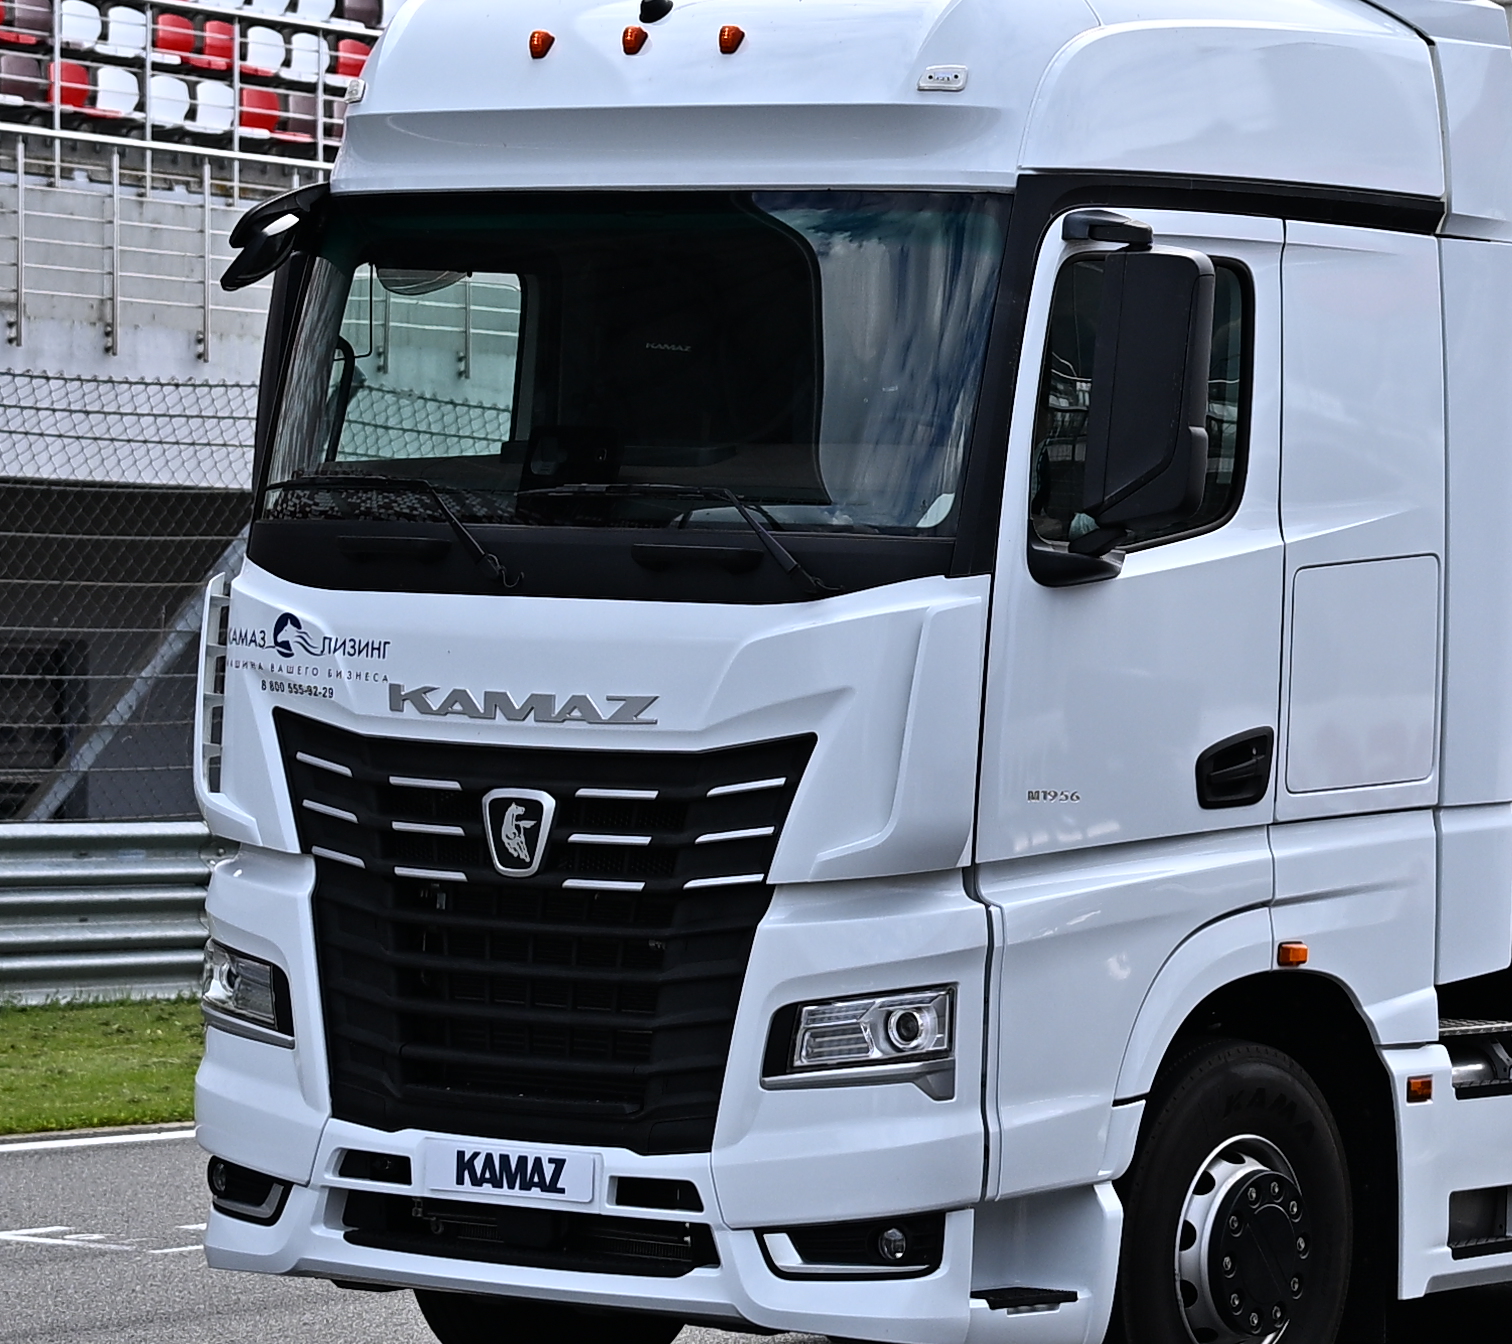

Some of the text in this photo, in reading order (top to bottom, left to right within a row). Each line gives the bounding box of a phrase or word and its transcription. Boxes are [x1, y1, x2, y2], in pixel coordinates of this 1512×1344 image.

[321, 635, 391, 660] ЛИЗИНГ
[270, 661, 320, 677] ВАШЕГО
[327, 668, 389, 683] БИЗНЕСА
[261, 679, 334, 698] 8 800 555-92-29
[388, 683, 660, 725] KAMAZ
[1027, 789, 1081, 803] M1956
[455, 1149, 567, 1195] KAMAZ
